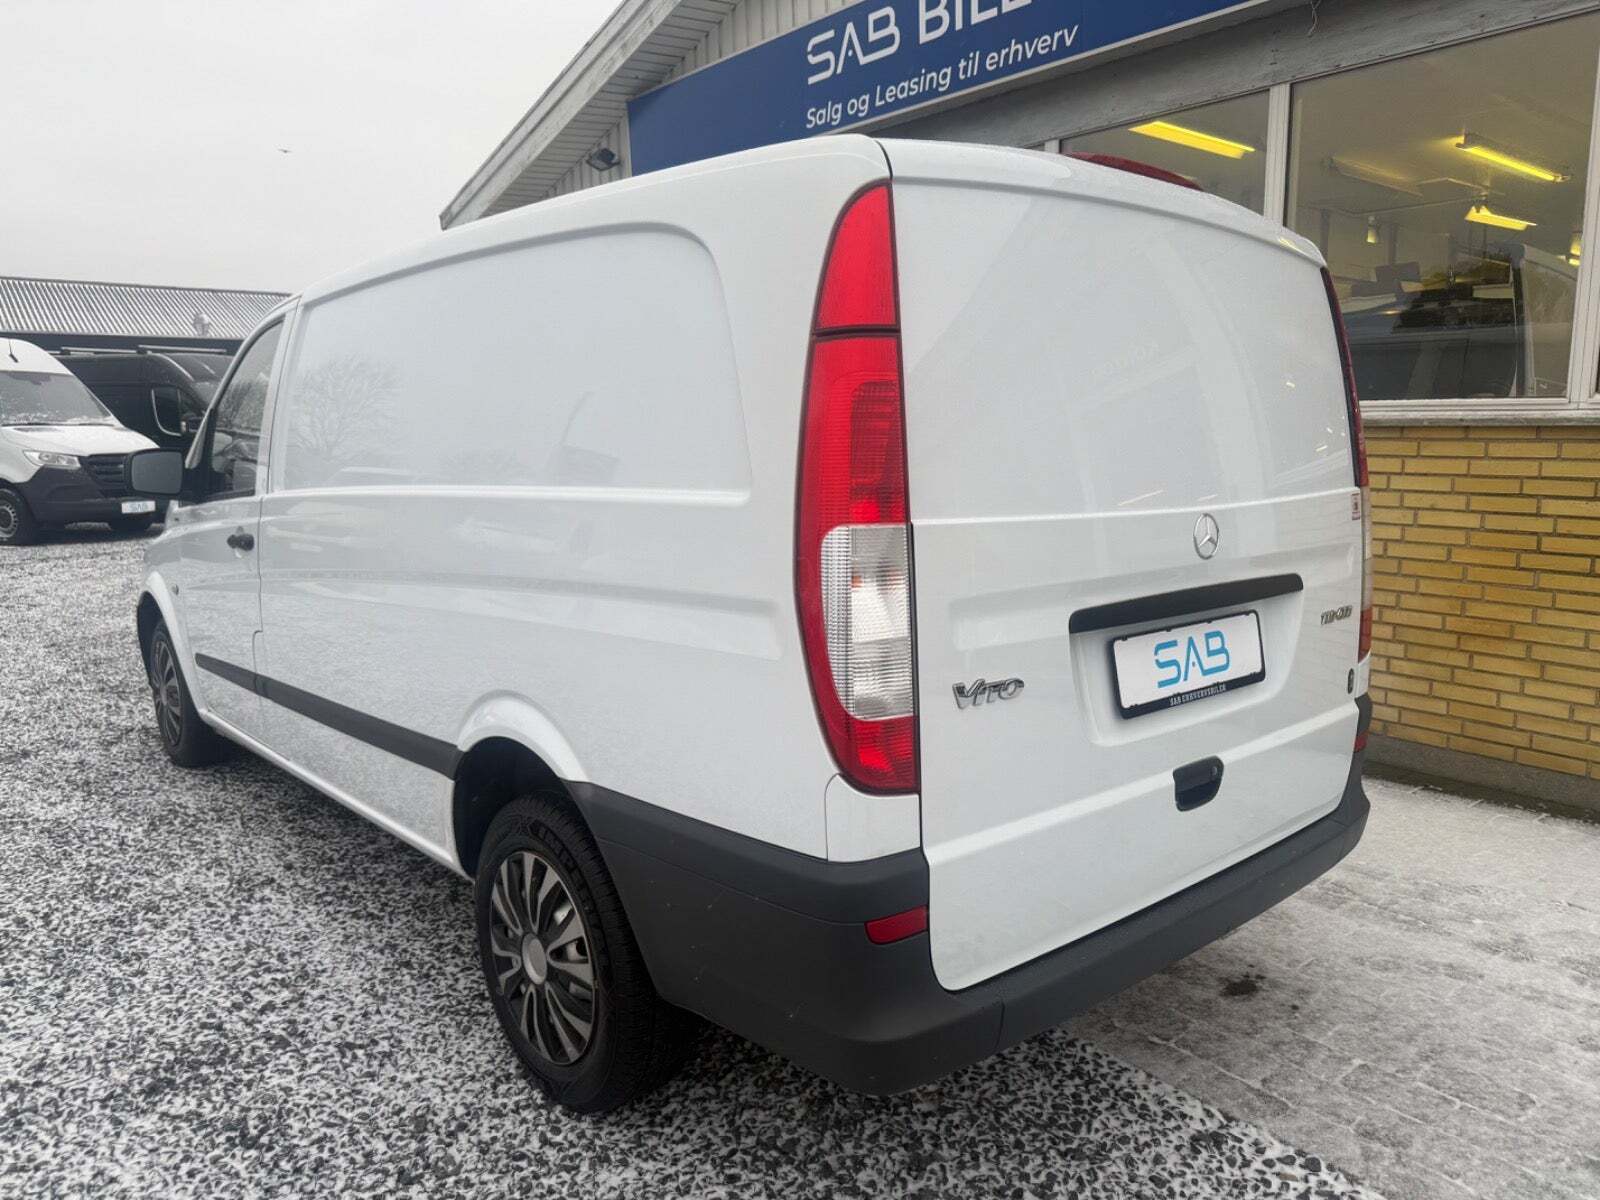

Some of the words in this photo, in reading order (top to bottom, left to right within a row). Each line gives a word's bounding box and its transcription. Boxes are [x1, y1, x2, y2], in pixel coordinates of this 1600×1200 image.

[806, 6, 901, 85] SAB
[806, 101, 842, 128] Salg
[847, 94, 870, 117] og
[875, 66, 951, 107] Leasing
[958, 51, 979, 80] til
[986, 25, 1079, 71] erhverv
[1154, 630, 1230, 688] SAB
